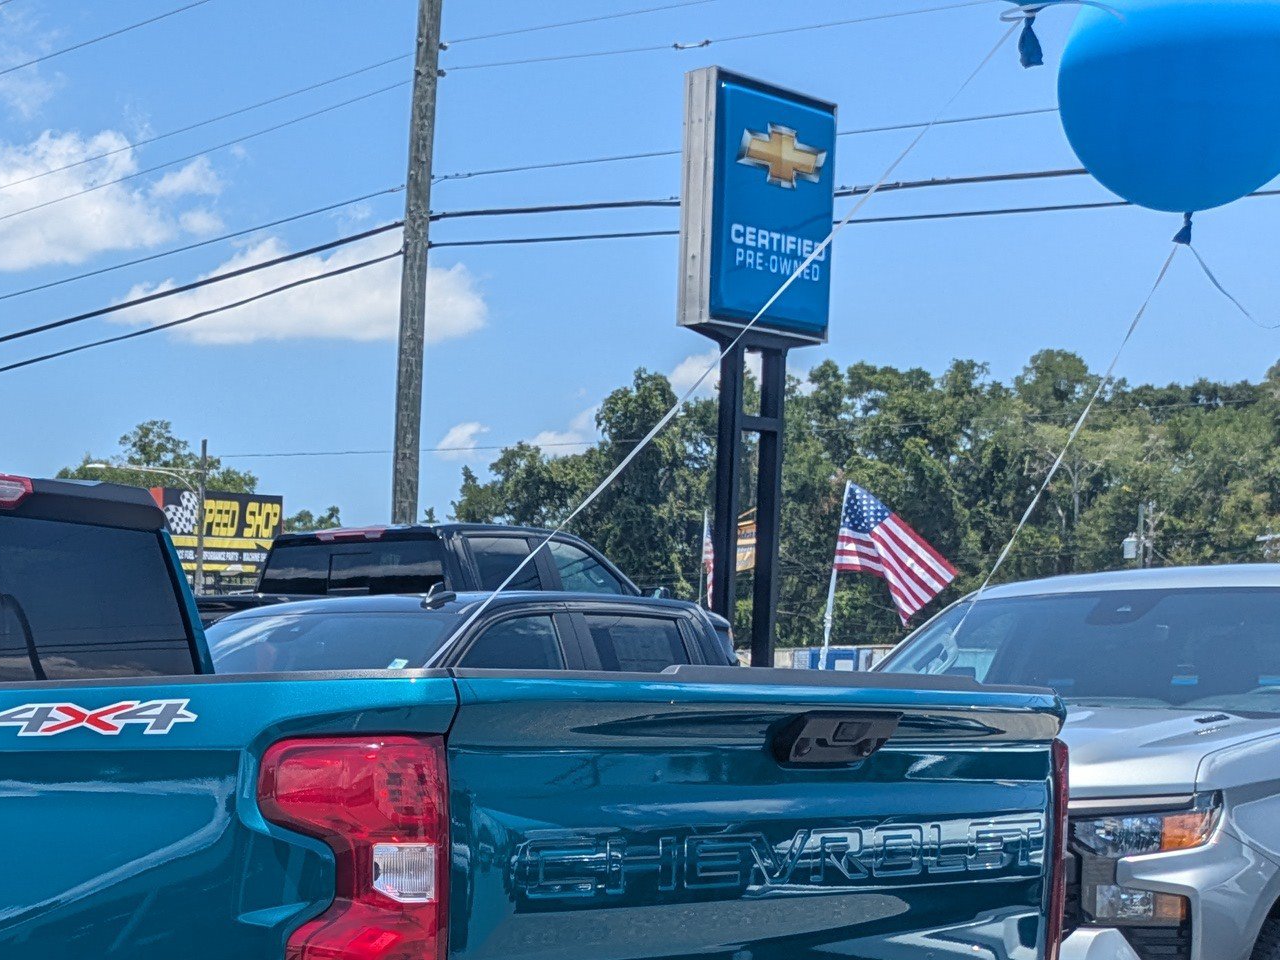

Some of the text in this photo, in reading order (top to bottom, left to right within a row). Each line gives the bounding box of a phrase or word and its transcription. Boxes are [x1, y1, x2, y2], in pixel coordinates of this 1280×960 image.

[731, 223, 825, 262] CERTIFIED
[736, 248, 820, 282] PRE-OWNED
[243, 501, 281, 539] SHOP
[525, 818, 1043, 899] CHEVROLET
